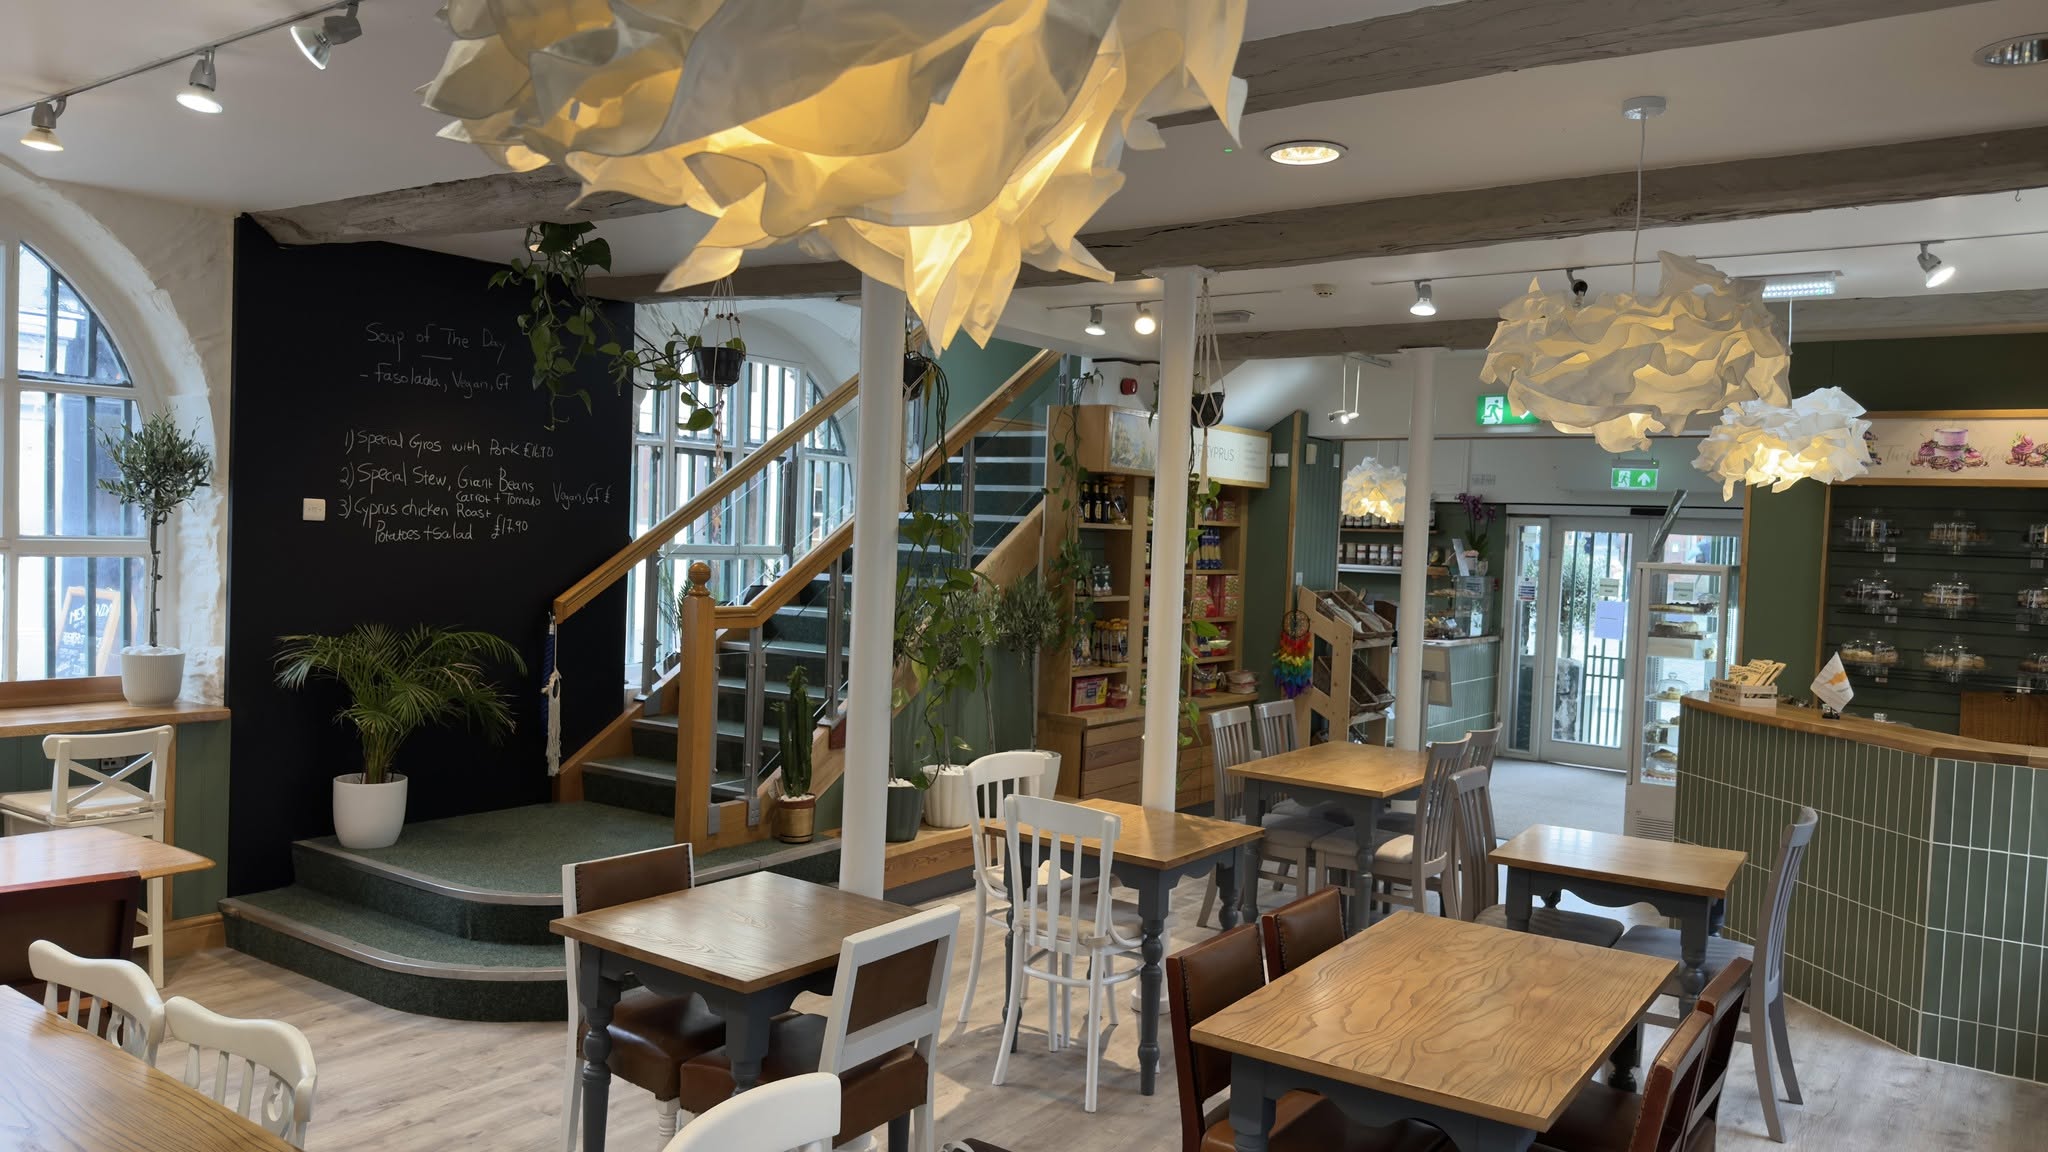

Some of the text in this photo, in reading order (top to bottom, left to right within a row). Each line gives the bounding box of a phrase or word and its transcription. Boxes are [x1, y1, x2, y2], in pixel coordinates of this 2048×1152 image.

[366, 322, 406, 362] Soup
[440, 327, 470, 348] The
[482, 328, 506, 364] Day
[452, 370, 493, 398] Vegan,
[409, 434, 442, 458] Gyros
[452, 436, 480, 455] with
[490, 438, 520, 456] Pork
[1207, 446, 1235, 462] YPRUS
[413, 466, 451, 491] Stew,
[457, 464, 493, 489] Giant
[499, 467, 535, 492] Beans
[456, 490, 492, 504] Carrot
[502, 492, 541, 507] Tomato
[456, 502, 492, 520] Roast
[374, 519, 421, 544] Potatoes
[490, 513, 529, 540] £17.90
